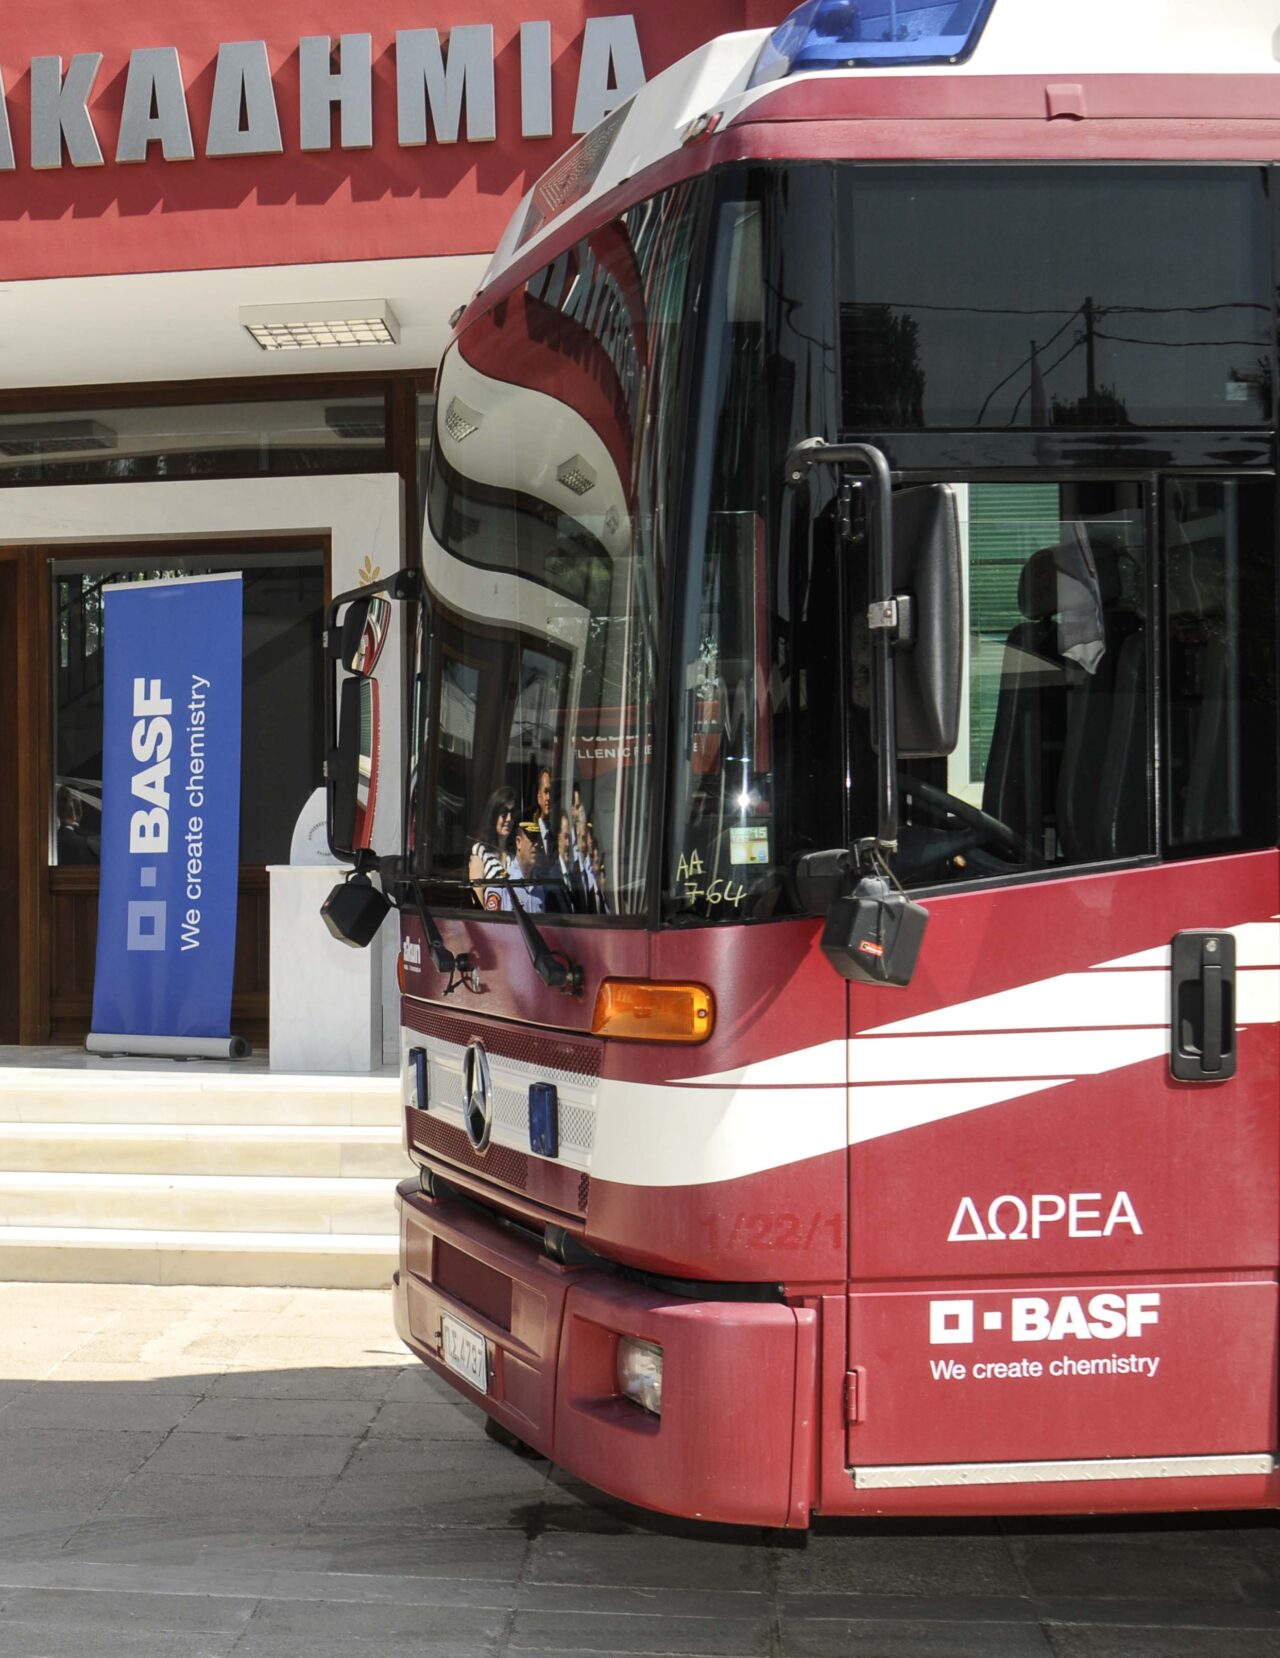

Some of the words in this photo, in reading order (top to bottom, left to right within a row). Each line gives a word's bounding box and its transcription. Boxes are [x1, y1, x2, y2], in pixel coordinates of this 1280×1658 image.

[129, 677, 173, 854] BASF
[184, 674, 211, 807] chemistry
[184, 815, 204, 900] create
[180, 908, 201, 951] We
[947, 1191, 1144, 1242] ΔΩΡΕΑ
[1011, 1293, 1161, 1342] BASF
[929, 1359, 967, 1381] We
[972, 1358, 1044, 1379] create
[1049, 1353, 1161, 1377] chemistry
